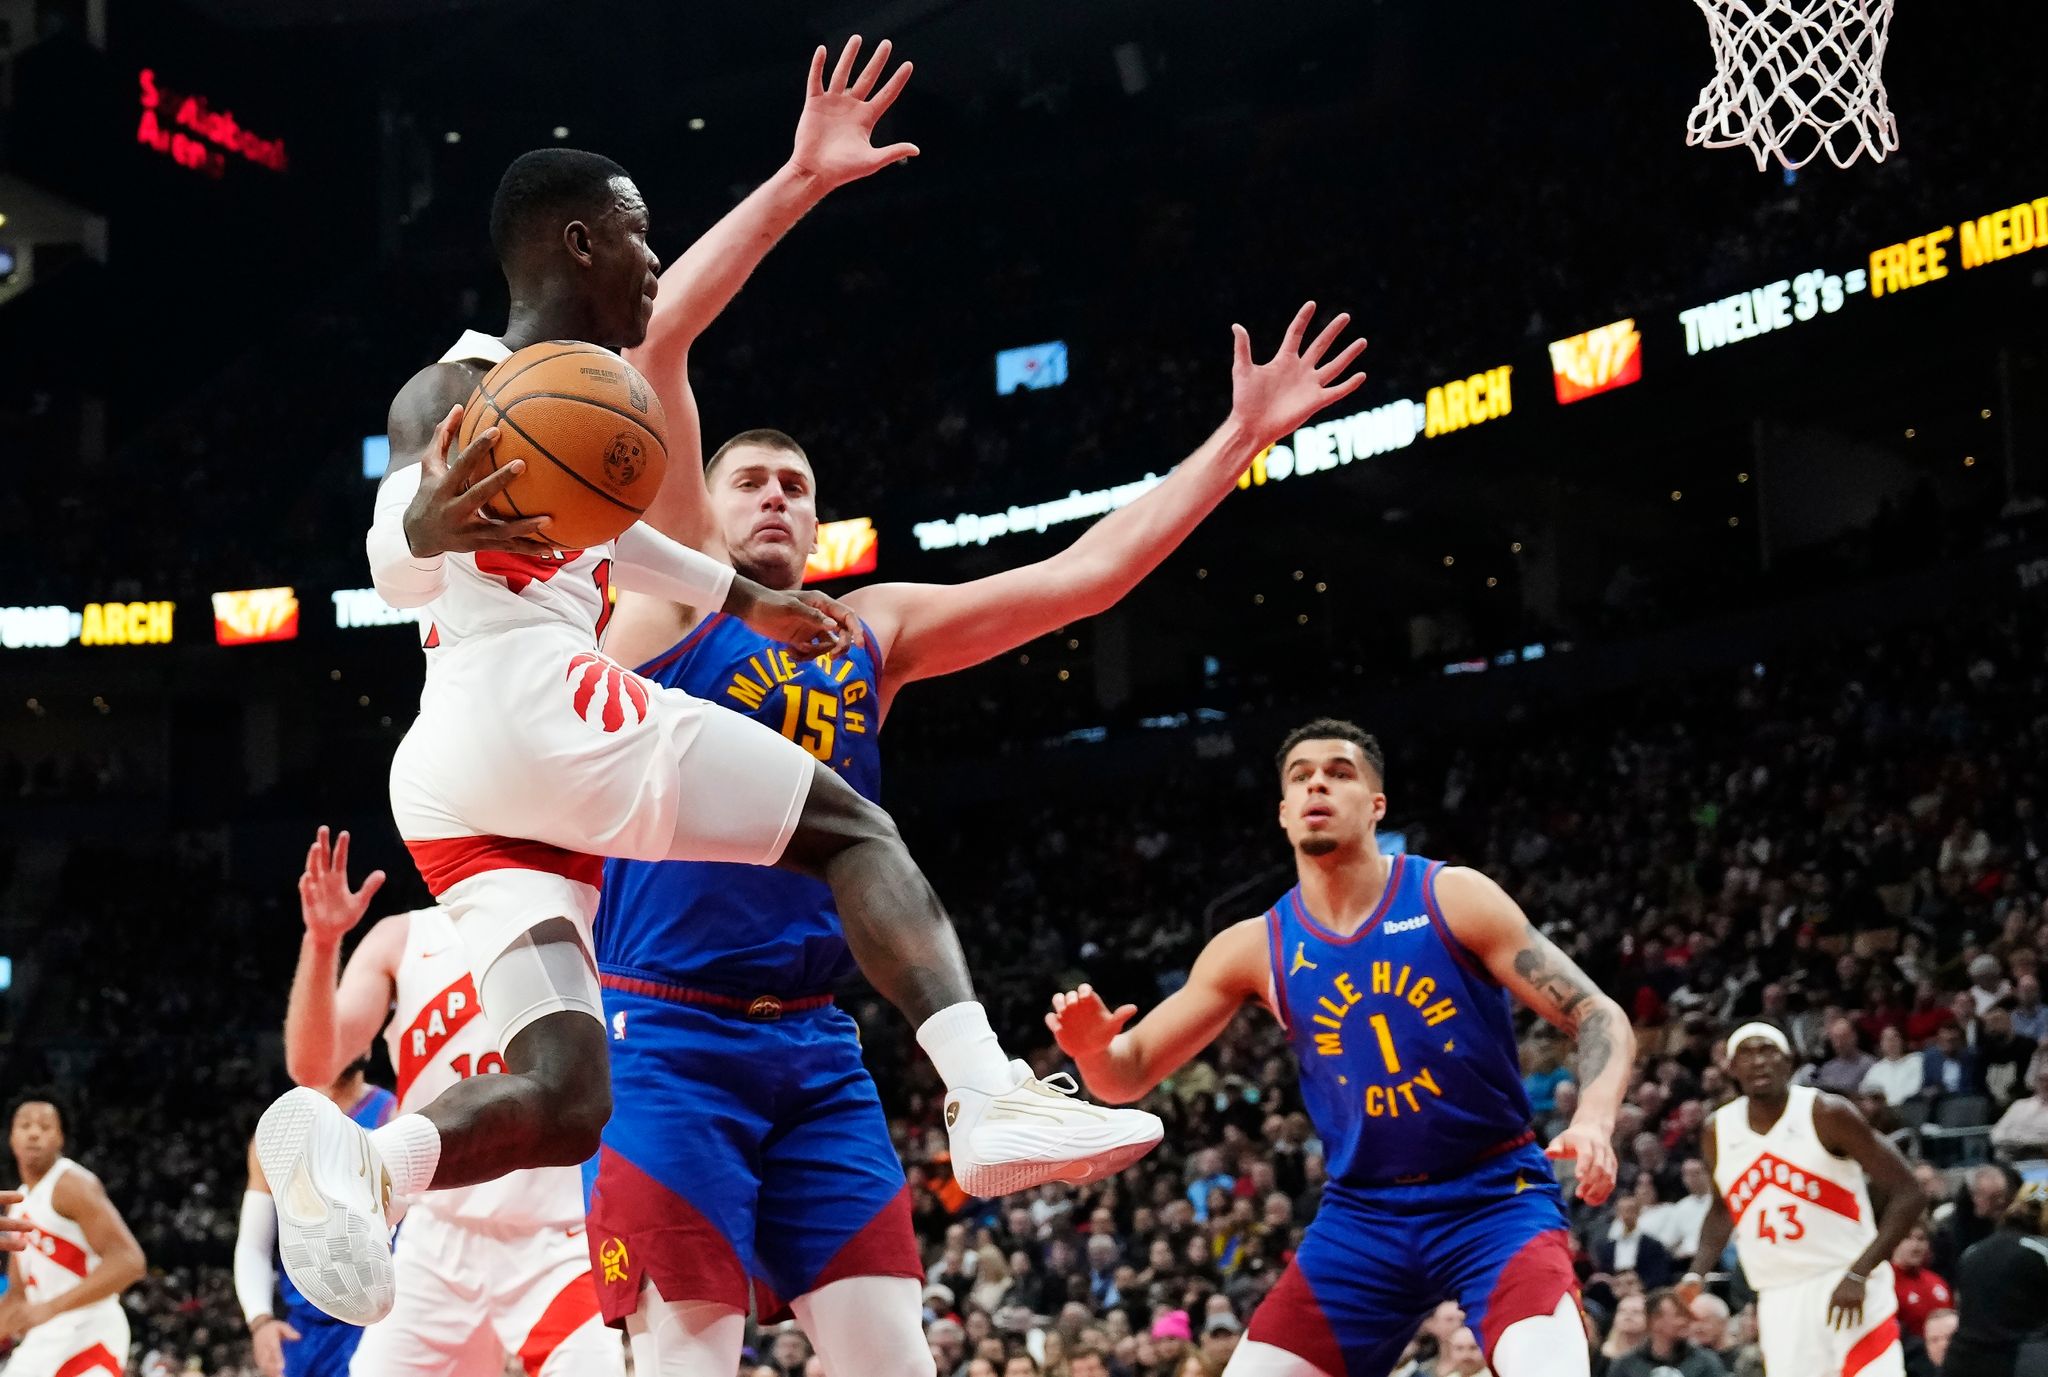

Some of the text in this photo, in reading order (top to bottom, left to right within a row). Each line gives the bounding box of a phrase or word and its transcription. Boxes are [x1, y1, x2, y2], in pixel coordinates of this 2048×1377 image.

[1679, 278, 1793, 356] TWELVE
[1295, 400, 1416, 475] BEYOND
[1427, 367, 1511, 437] ARCH
[80, 601, 175, 646] ARCH
[727, 648, 803, 710] MILE
[781, 684, 838, 761] 15
[1313, 961, 1458, 1056] MILE HIGH
[1369, 1013, 1401, 1075] 1
[1366, 1067, 1443, 1118] CITY
[1757, 1204, 1806, 1245] 43
